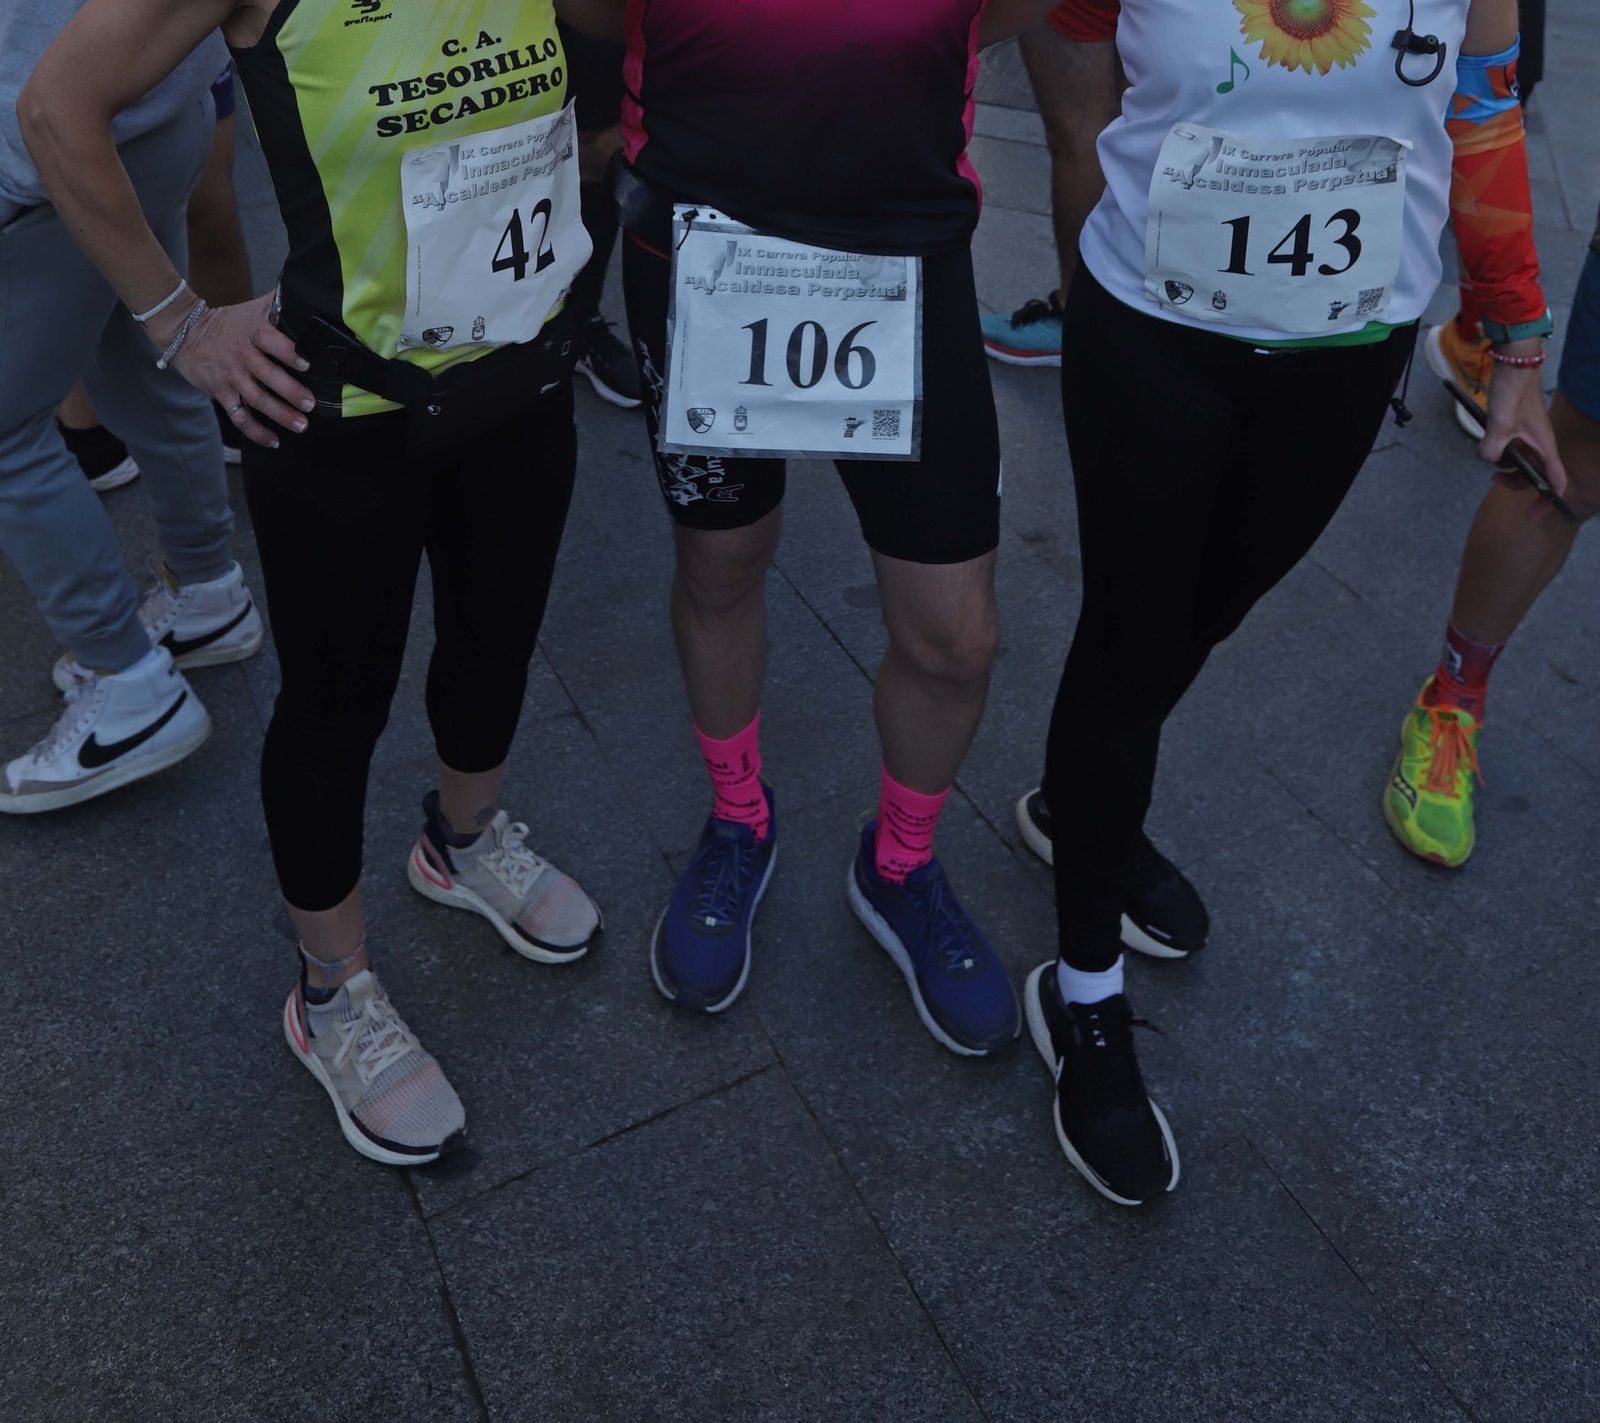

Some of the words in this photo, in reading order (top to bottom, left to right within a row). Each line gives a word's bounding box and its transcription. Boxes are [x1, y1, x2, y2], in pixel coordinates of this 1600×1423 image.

[441, 38, 468, 57] C.
[475, 30, 502, 49] A.
[368, 37, 558, 107] TESORILLO
[376, 66, 564, 138] SECADERO
[460, 148, 475, 161] IX
[480, 138, 524, 156] Carrera
[1221, 145, 1237, 157] IX
[1240, 149, 1295, 162] Carrera
[1298, 143, 1352, 157] Popular
[1215, 156, 1347, 179] Inmaculada
[491, 197, 556, 282] 42
[1216, 208, 1363, 277] 143
[737, 247, 752, 259] IX
[755, 248, 808, 261] Carrera
[812, 251, 863, 263] Popular
[735, 260, 860, 280] Inmaculada
[737, 317, 879, 390] 106
